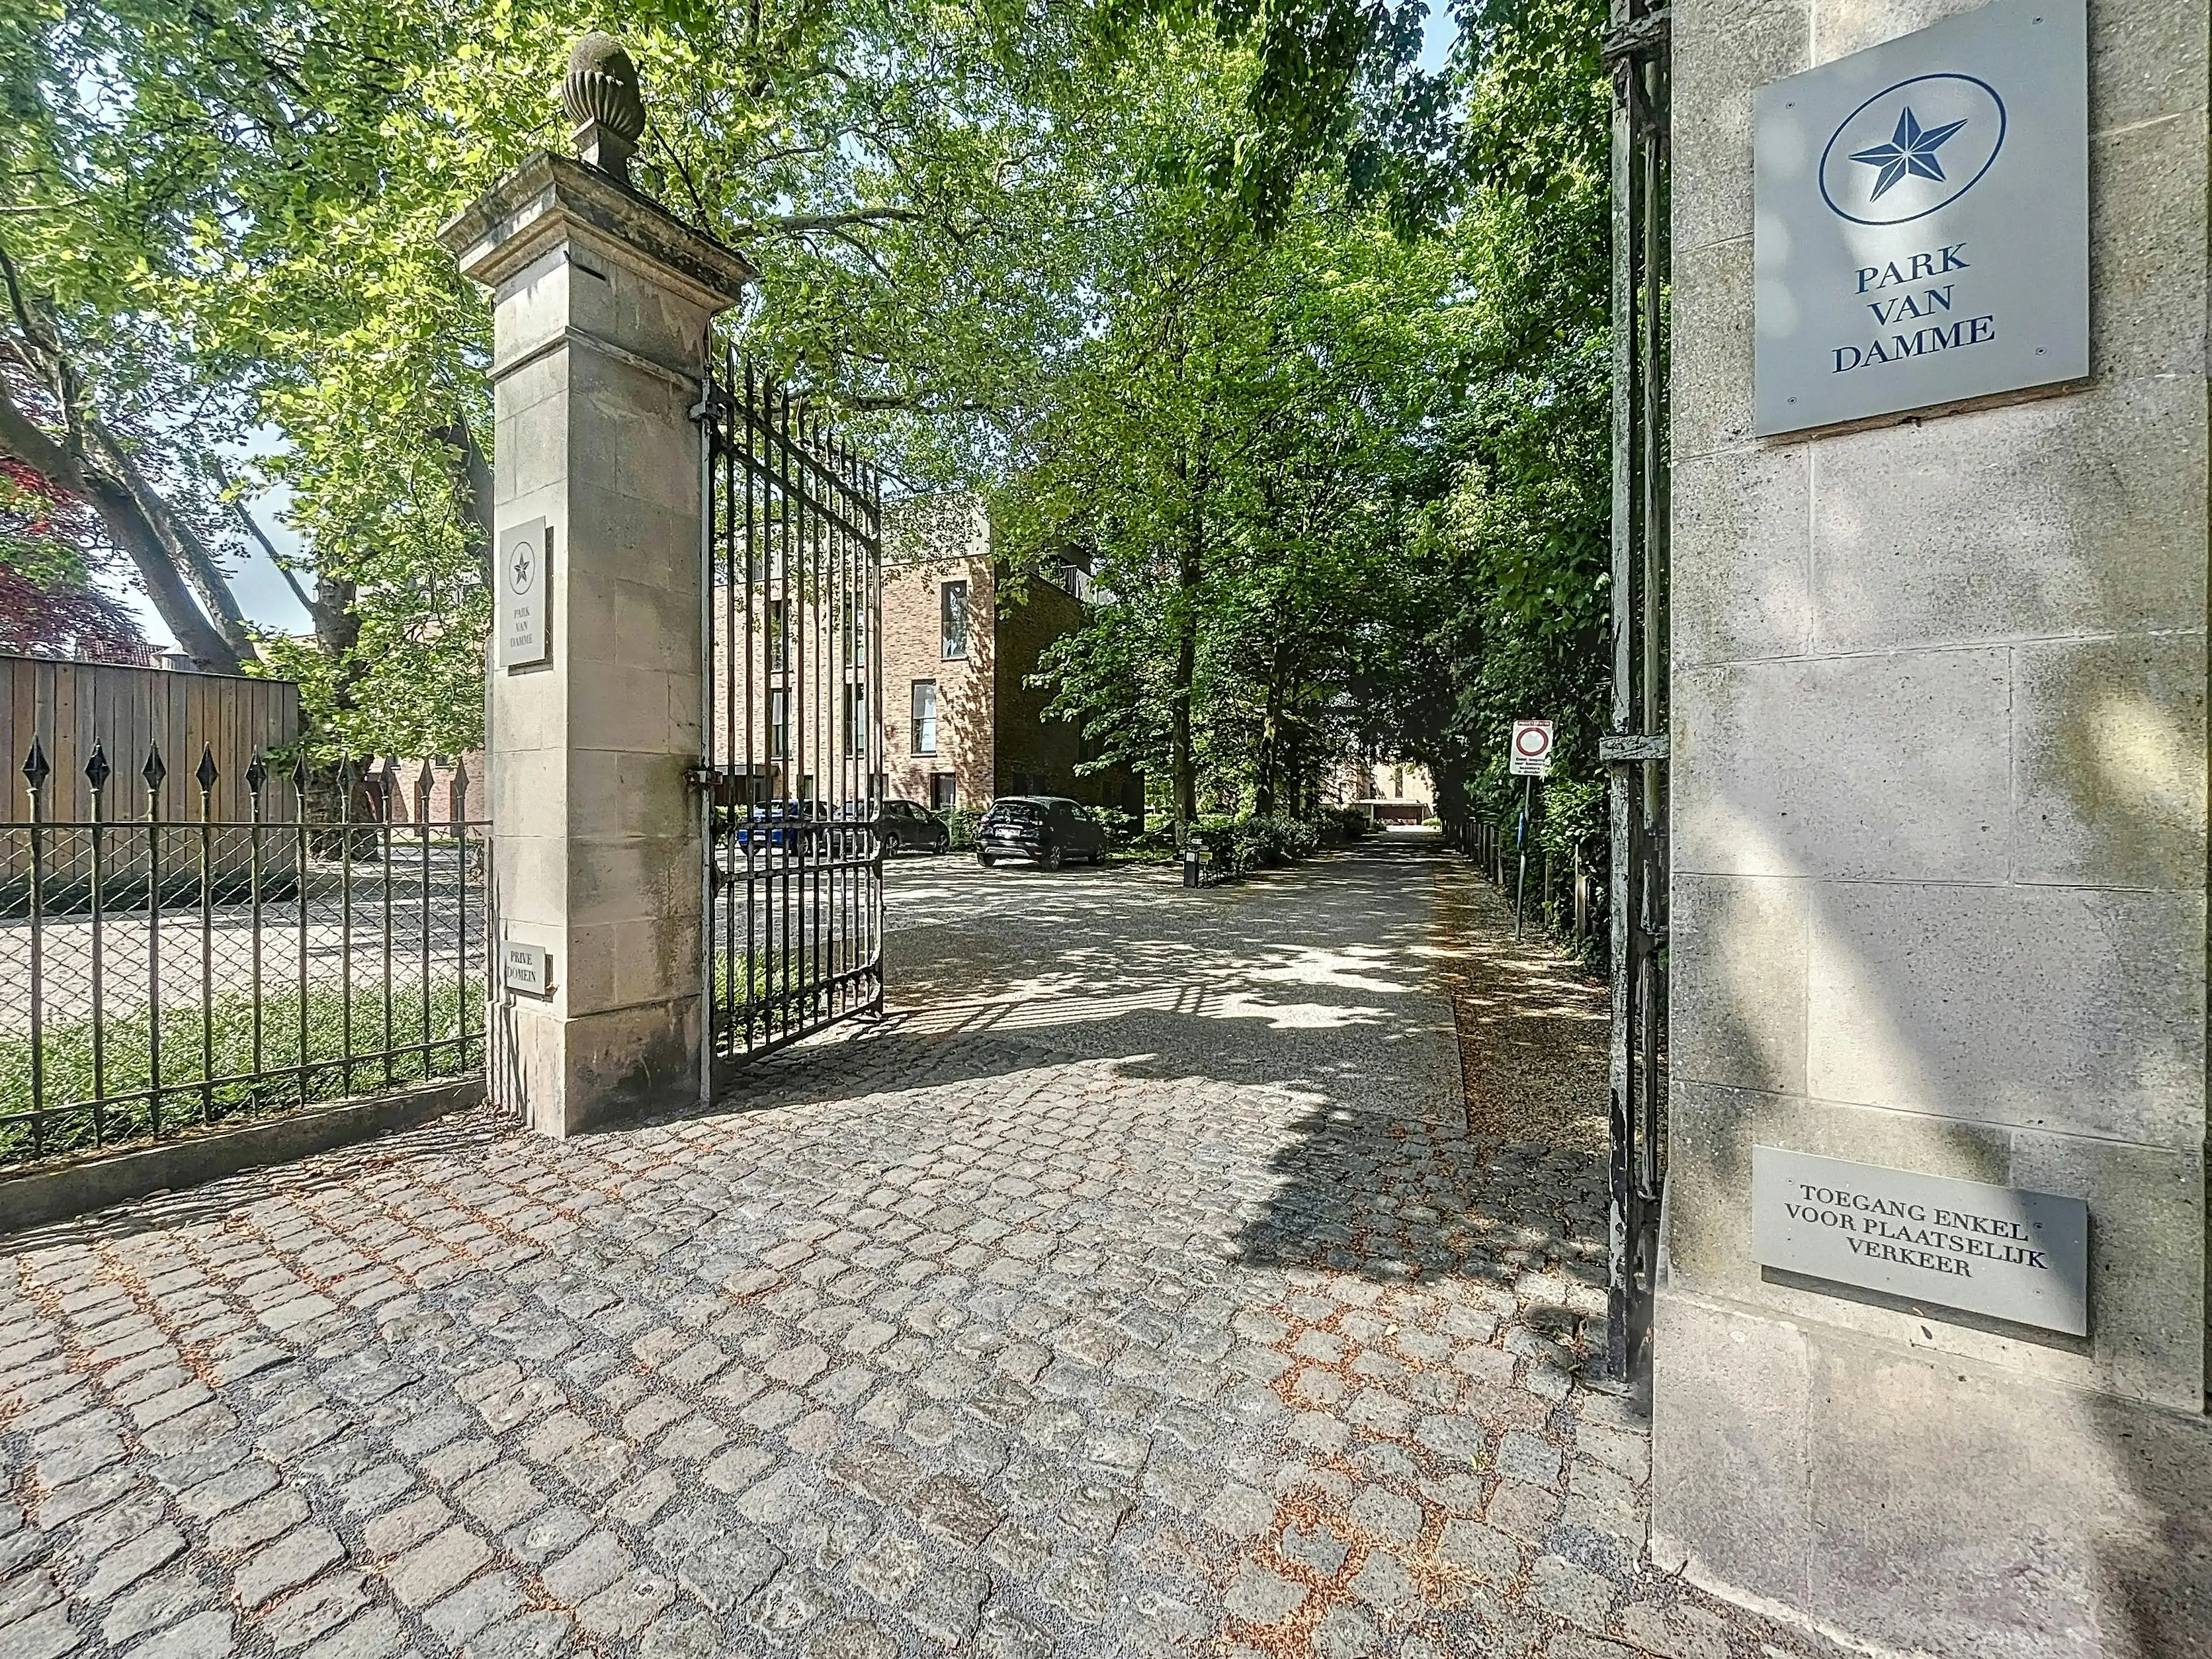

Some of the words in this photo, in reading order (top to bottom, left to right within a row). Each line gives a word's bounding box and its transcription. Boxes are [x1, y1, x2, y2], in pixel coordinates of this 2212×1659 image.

[1855, 243, 1971, 294] PARK
[1867, 284, 1955, 326] VAN
[1832, 315, 1995, 373] DAMME
[514, 607, 530, 619] PARK
[516, 621, 528, 632] VAN
[510, 634, 533, 648] DAMME
[507, 966, 536, 983] DOMEIN
[1800, 1185, 1926, 1221] TOEGANG
[1934, 1209, 2029, 1242] ENKEL
[1784, 1203, 1856, 1231] VOOR
[1863, 1218, 2048, 1269] PLAATSELIJK
[1846, 1236, 1973, 1277] VERKEER
